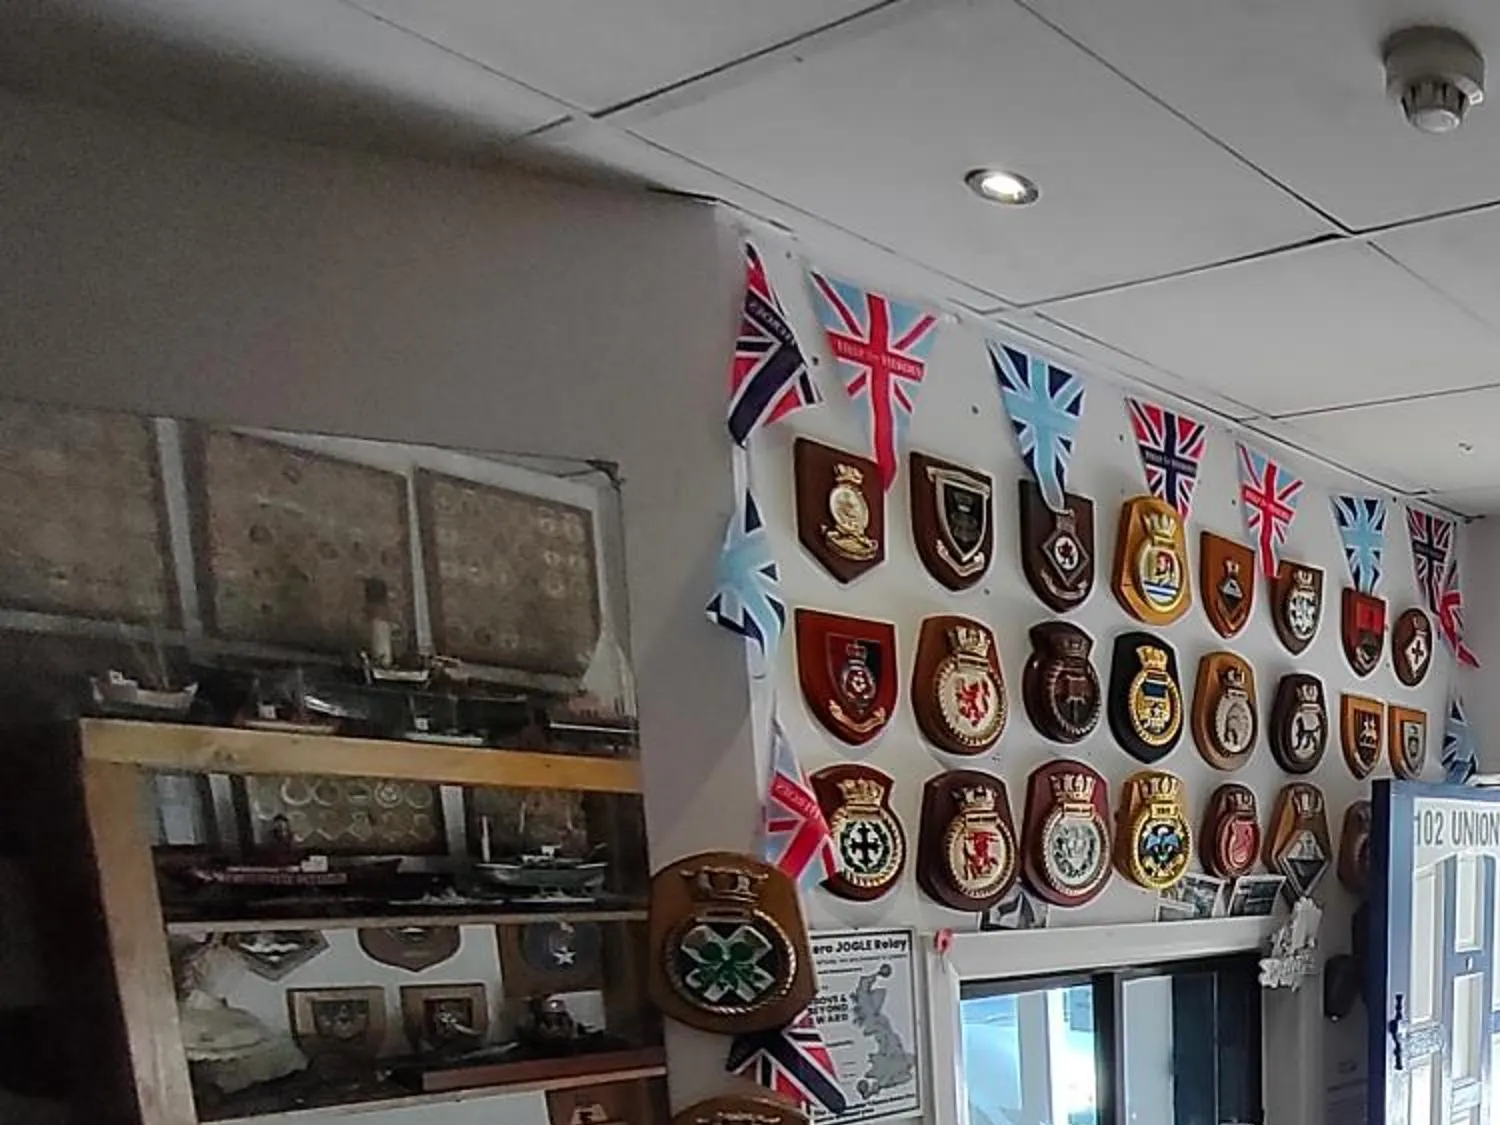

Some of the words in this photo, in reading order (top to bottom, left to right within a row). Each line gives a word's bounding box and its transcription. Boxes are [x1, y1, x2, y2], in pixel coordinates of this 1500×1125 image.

[1415, 808, 1443, 847] 102
[1451, 810, 1500, 847] UNION
[874, 936, 908, 952] Relay
